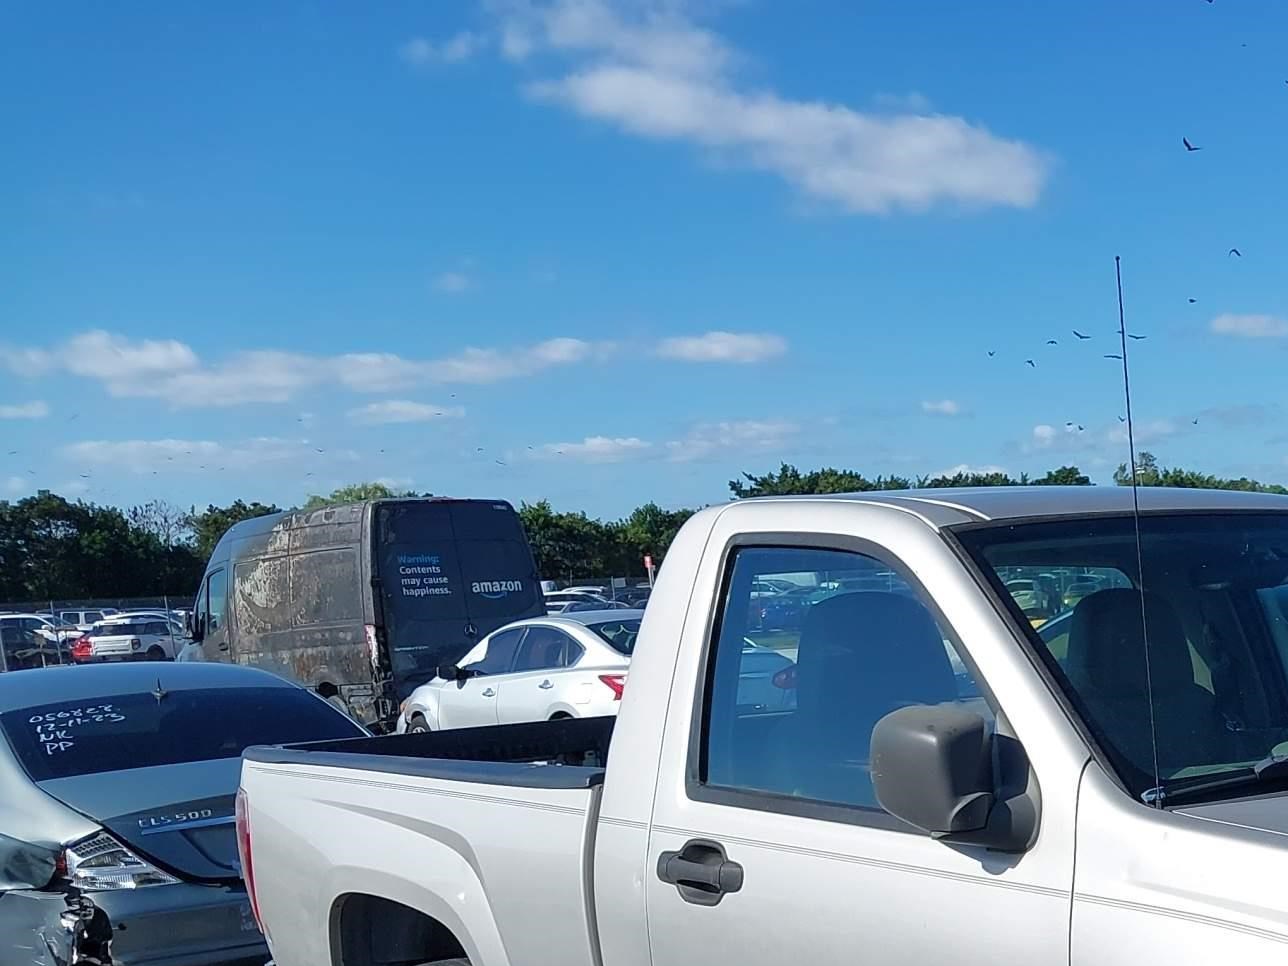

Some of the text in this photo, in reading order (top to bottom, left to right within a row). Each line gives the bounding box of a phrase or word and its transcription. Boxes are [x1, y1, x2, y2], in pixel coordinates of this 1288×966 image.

[397, 554, 440, 565] Warning:
[399, 565, 441, 575] Contents
[401, 576, 449, 587] may cause
[471, 580, 523, 594] amazon
[402, 585, 453, 598] happiness.
[138, 808, 213, 828] CLS 500
